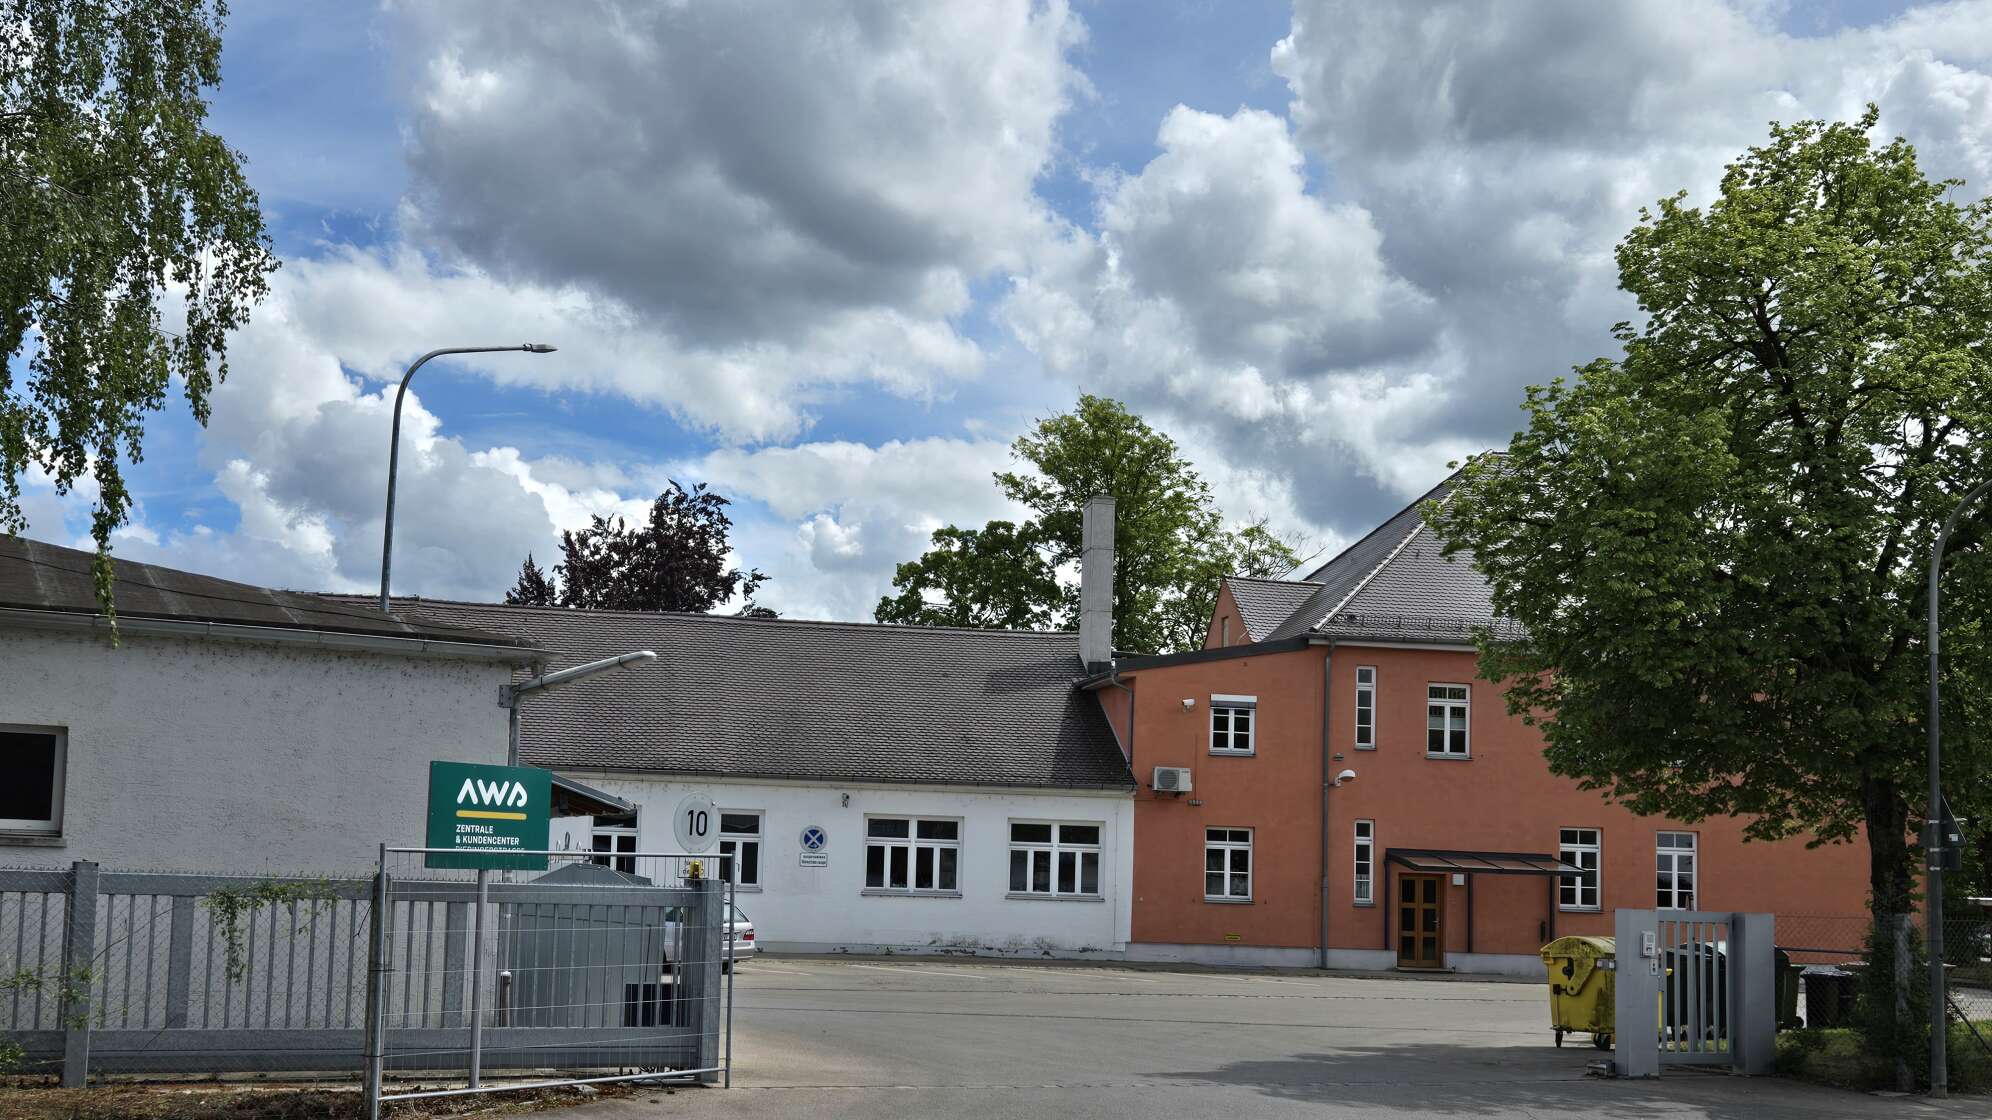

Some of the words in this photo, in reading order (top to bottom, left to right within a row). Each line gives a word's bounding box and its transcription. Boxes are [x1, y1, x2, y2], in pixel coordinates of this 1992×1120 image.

[687, 809, 708, 837] 10
[455, 824, 494, 834] ZENTRALE
[455, 835, 461, 844] &
[462, 835, 520, 845] KUNDENCENTER
